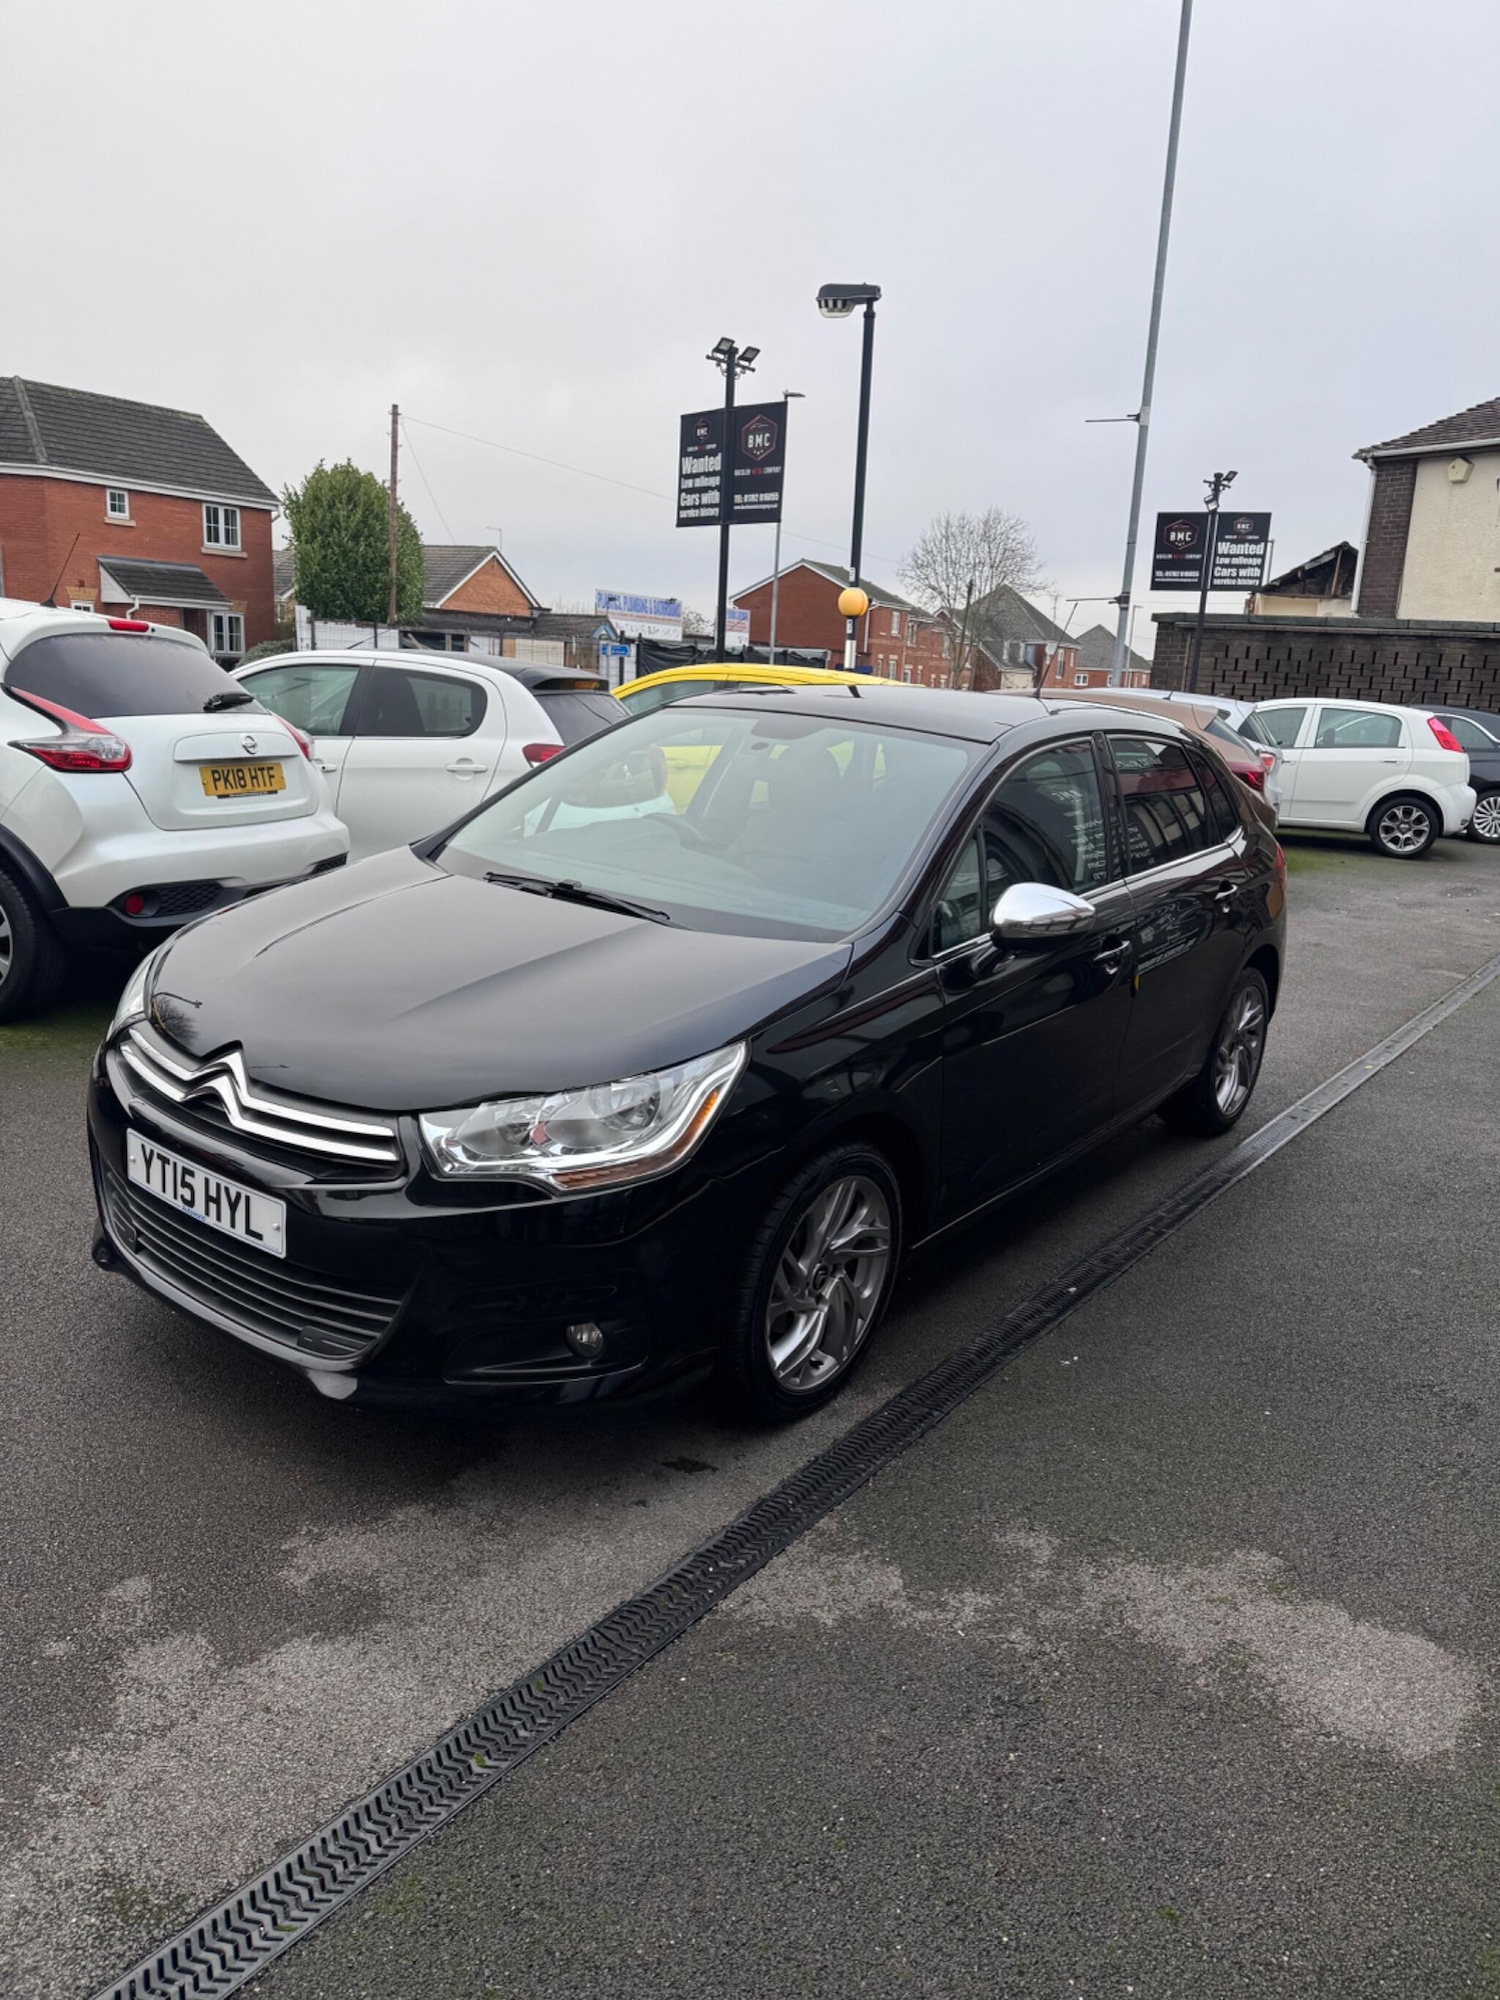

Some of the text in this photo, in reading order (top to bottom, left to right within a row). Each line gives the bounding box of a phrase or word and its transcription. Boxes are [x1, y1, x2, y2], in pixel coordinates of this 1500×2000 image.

[747, 433, 771, 448] BMC
[681, 453, 722, 475] Wanted
[681, 476, 720, 489] Low mileage
[680, 490, 720, 507] Cars with
[679, 507, 719, 518] service history
[1170, 532, 1192, 541] BMC
[1218, 542, 1265, 555] Wanted
[1231, 557, 1262, 566] mileage
[1214, 566, 1261, 577] Cars with
[1236, 578, 1260, 586] history
[211, 766, 275, 791] PK18 HTF
[141, 1143, 263, 1241] YT15 HYL
